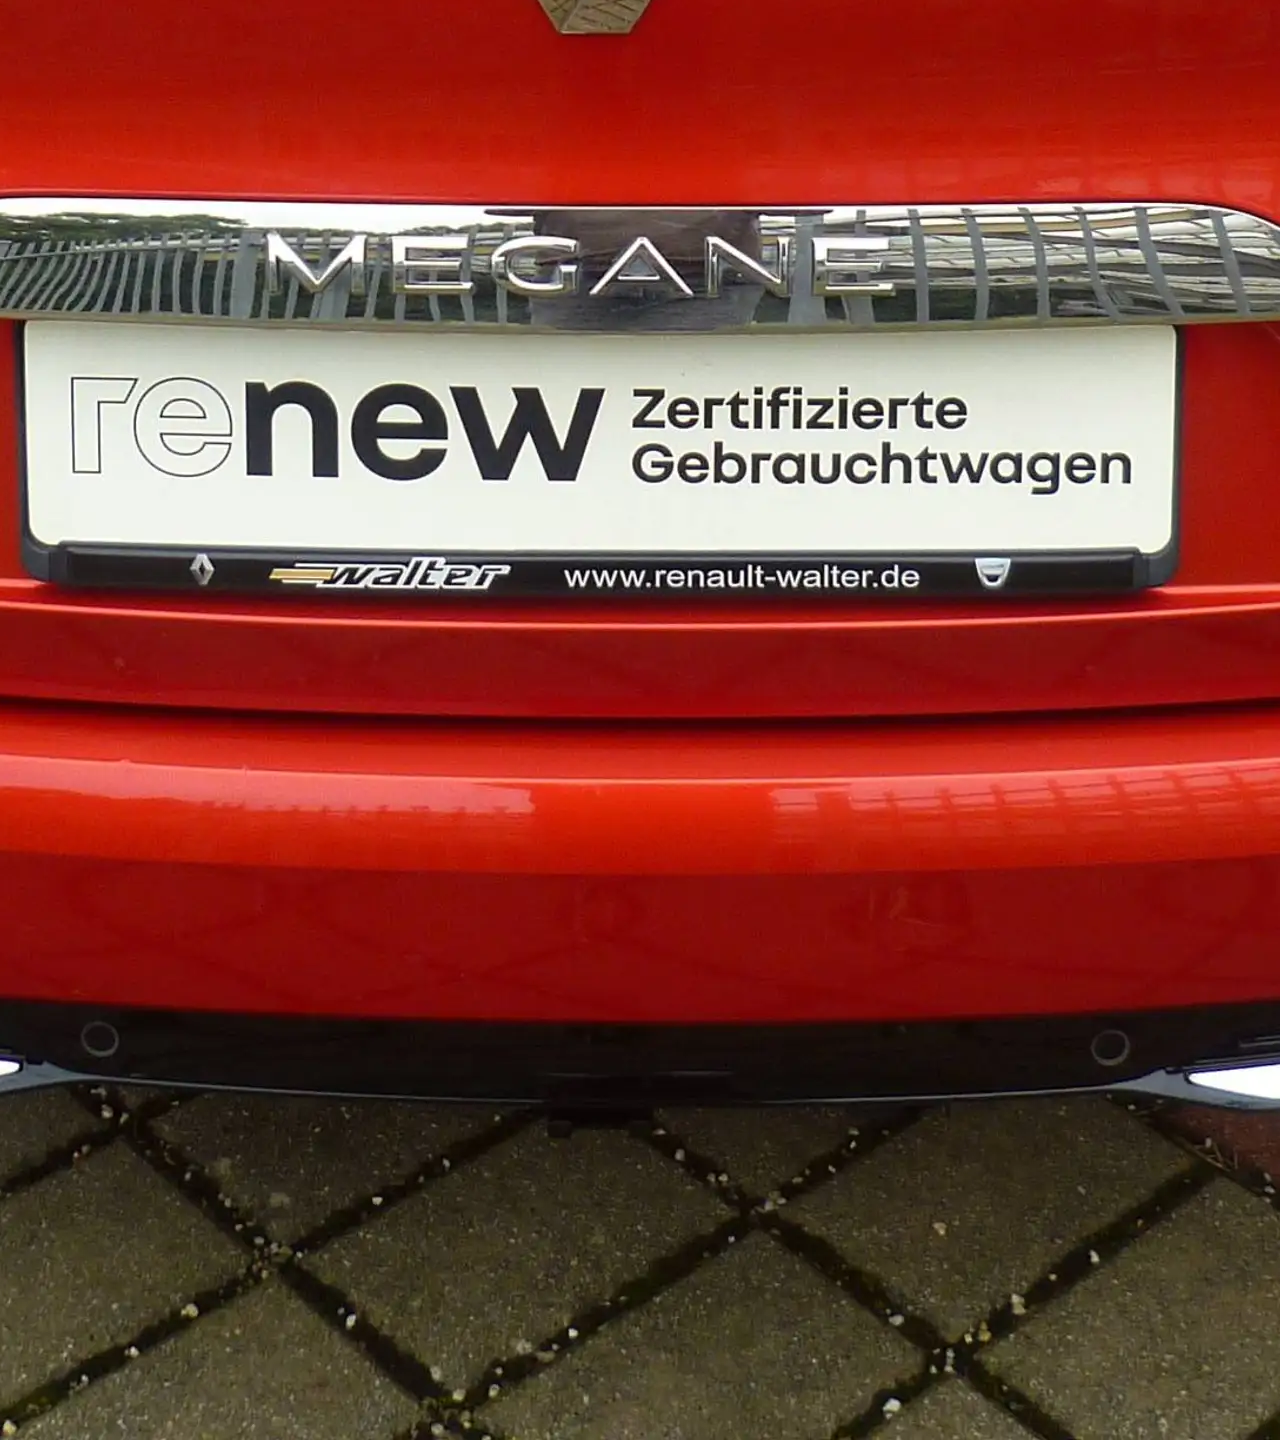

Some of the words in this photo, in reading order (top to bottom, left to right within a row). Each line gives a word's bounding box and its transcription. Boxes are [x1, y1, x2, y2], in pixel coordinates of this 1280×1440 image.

[264, 230, 897, 298] MEGANE
[71, 375, 606, 482] renew
[631, 385, 968, 430] Zertifizierte
[631, 441, 1133, 496] Gebrauchtwagen
[320, 557, 511, 589] walter
[564, 563, 921, 589] www.renault-walter.de
